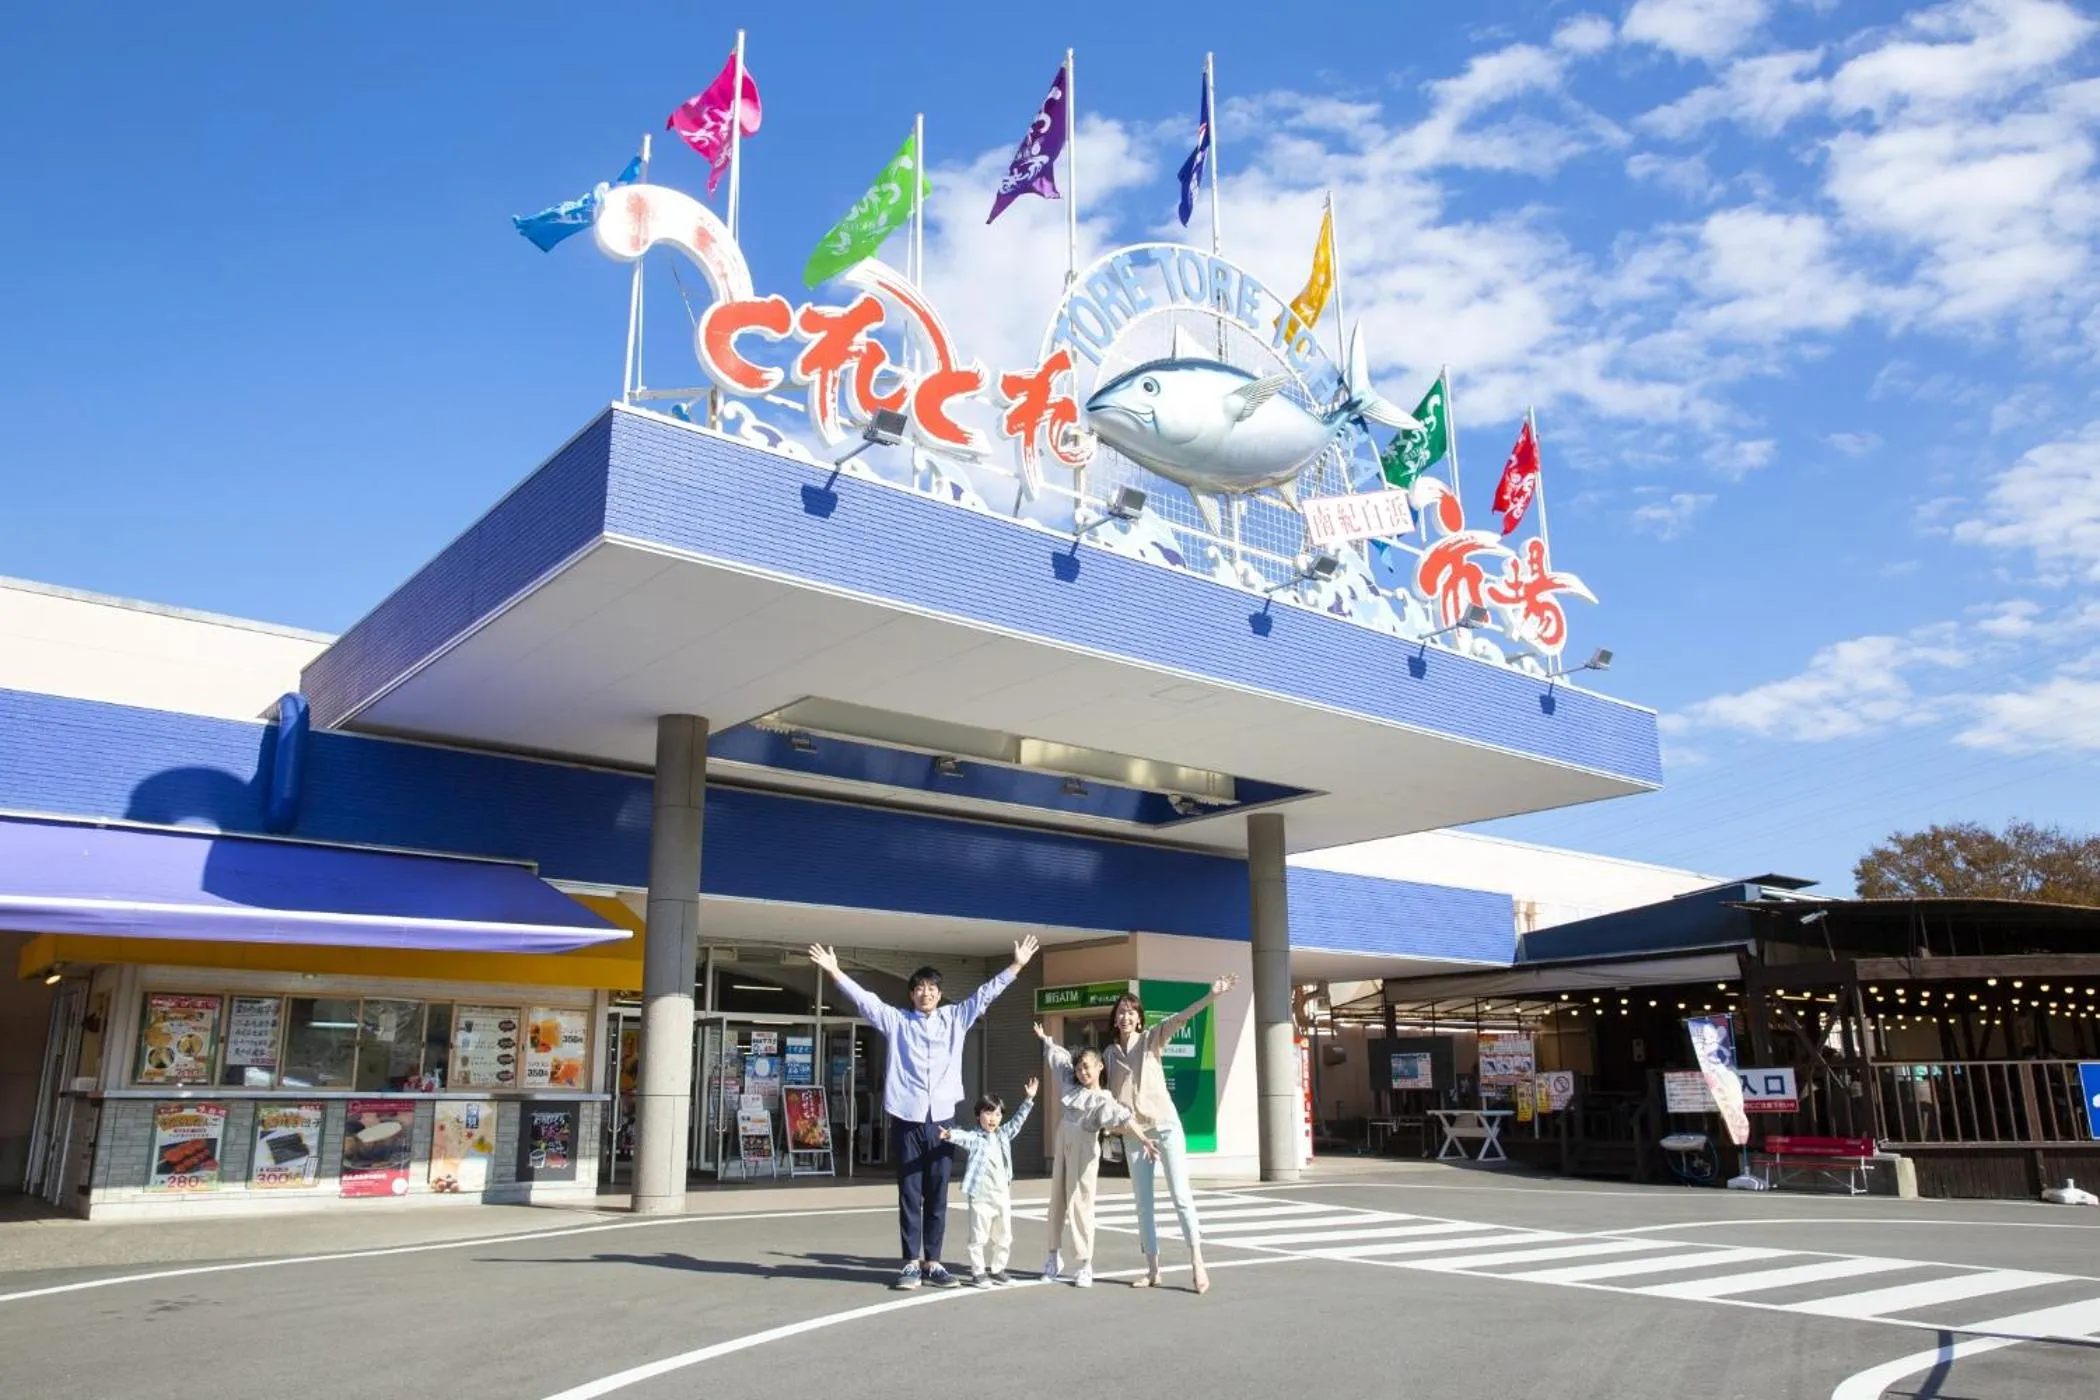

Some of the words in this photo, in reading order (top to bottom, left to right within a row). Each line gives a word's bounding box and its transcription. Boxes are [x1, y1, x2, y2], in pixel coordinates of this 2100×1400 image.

[594, 184, 1098, 502] とれとれ
[1053, 253, 1154, 366] TORE
[1149, 247, 1266, 329] TORE
[1312, 496, 1410, 540] 南紀白浜
